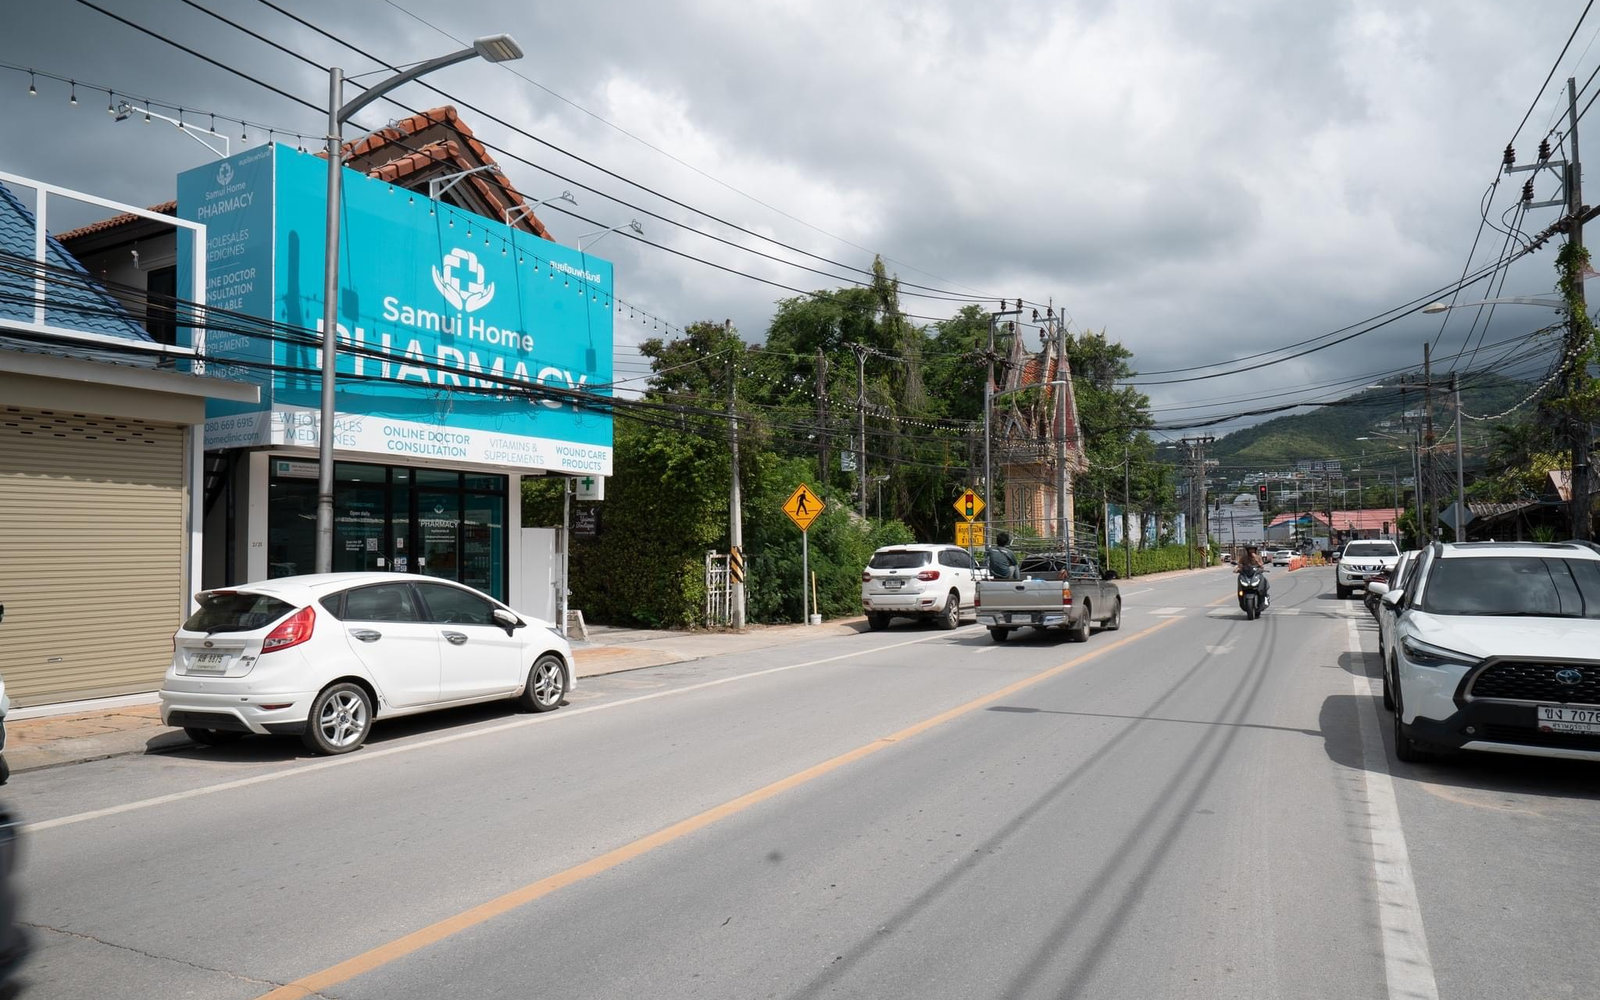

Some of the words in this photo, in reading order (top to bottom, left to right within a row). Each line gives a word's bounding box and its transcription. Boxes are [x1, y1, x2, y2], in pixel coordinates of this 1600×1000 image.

[205, 187, 225, 201] Samui
[226, 182, 246, 194] Home
[197, 191, 254, 220] PHARMACY
[206, 228, 249, 250] HOLESALES
[223, 267, 256, 286] DOCTOR
[206, 281, 253, 302] NSULTATION
[383, 296, 462, 336] Samui
[469, 316, 534, 351] Home
[236, 417, 254, 428] 6915
[279, 412, 363, 433] WHOLALES
[285, 428, 357, 447] MEDINES
[383, 425, 425, 441] ONLINE
[427, 431, 470, 445] DOCTOR
[387, 440, 467, 457] CONSULTATION
[489, 438, 530, 452] VITAMINS
[556, 445, 587, 458] WOUND
[587, 450, 607, 460] CARE
[483, 450, 545, 465] SUPPLEMENTS
[562, 458, 602, 470] PRODUCTS
[420, 519, 459, 528] PHARMACY
